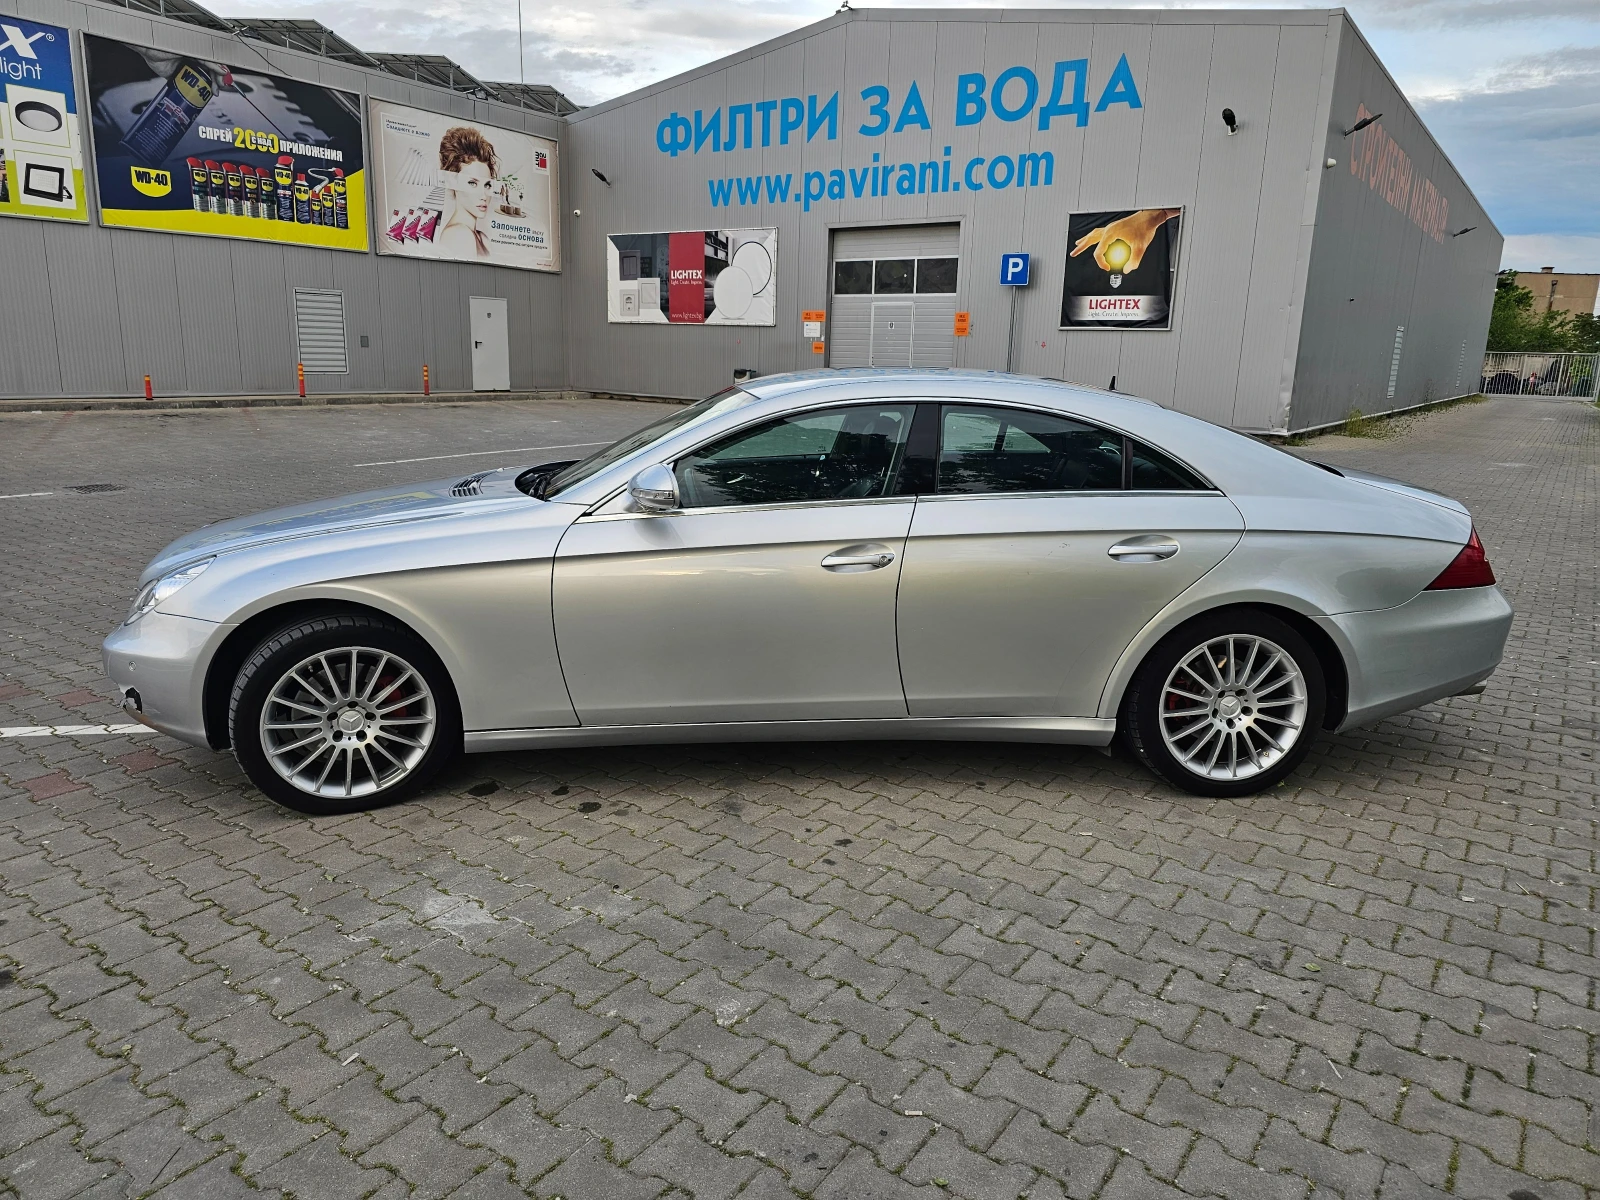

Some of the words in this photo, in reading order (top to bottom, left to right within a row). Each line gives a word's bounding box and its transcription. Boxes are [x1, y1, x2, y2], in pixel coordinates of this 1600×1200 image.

[180, 68, 211, 102] WD-40
[656, 90, 839, 157] ФИЛТРИ
[858, 80, 931, 137] ЗА
[954, 52, 1143, 132] ВОДА
[198, 125, 233, 143] СПРЕЙ
[280, 139, 343, 162] ПРИЛОЖЕНИЯ
[134, 169, 169, 187] WD-40
[708, 146, 1054, 212] www.pavirani.com
[491, 220, 531, 234] Започнете
[518, 234, 544, 243] основа
[670, 269, 703, 280] LIGHTEX
[1007, 257, 1024, 281] P
[1088, 298, 1141, 310] LIGHTEX
